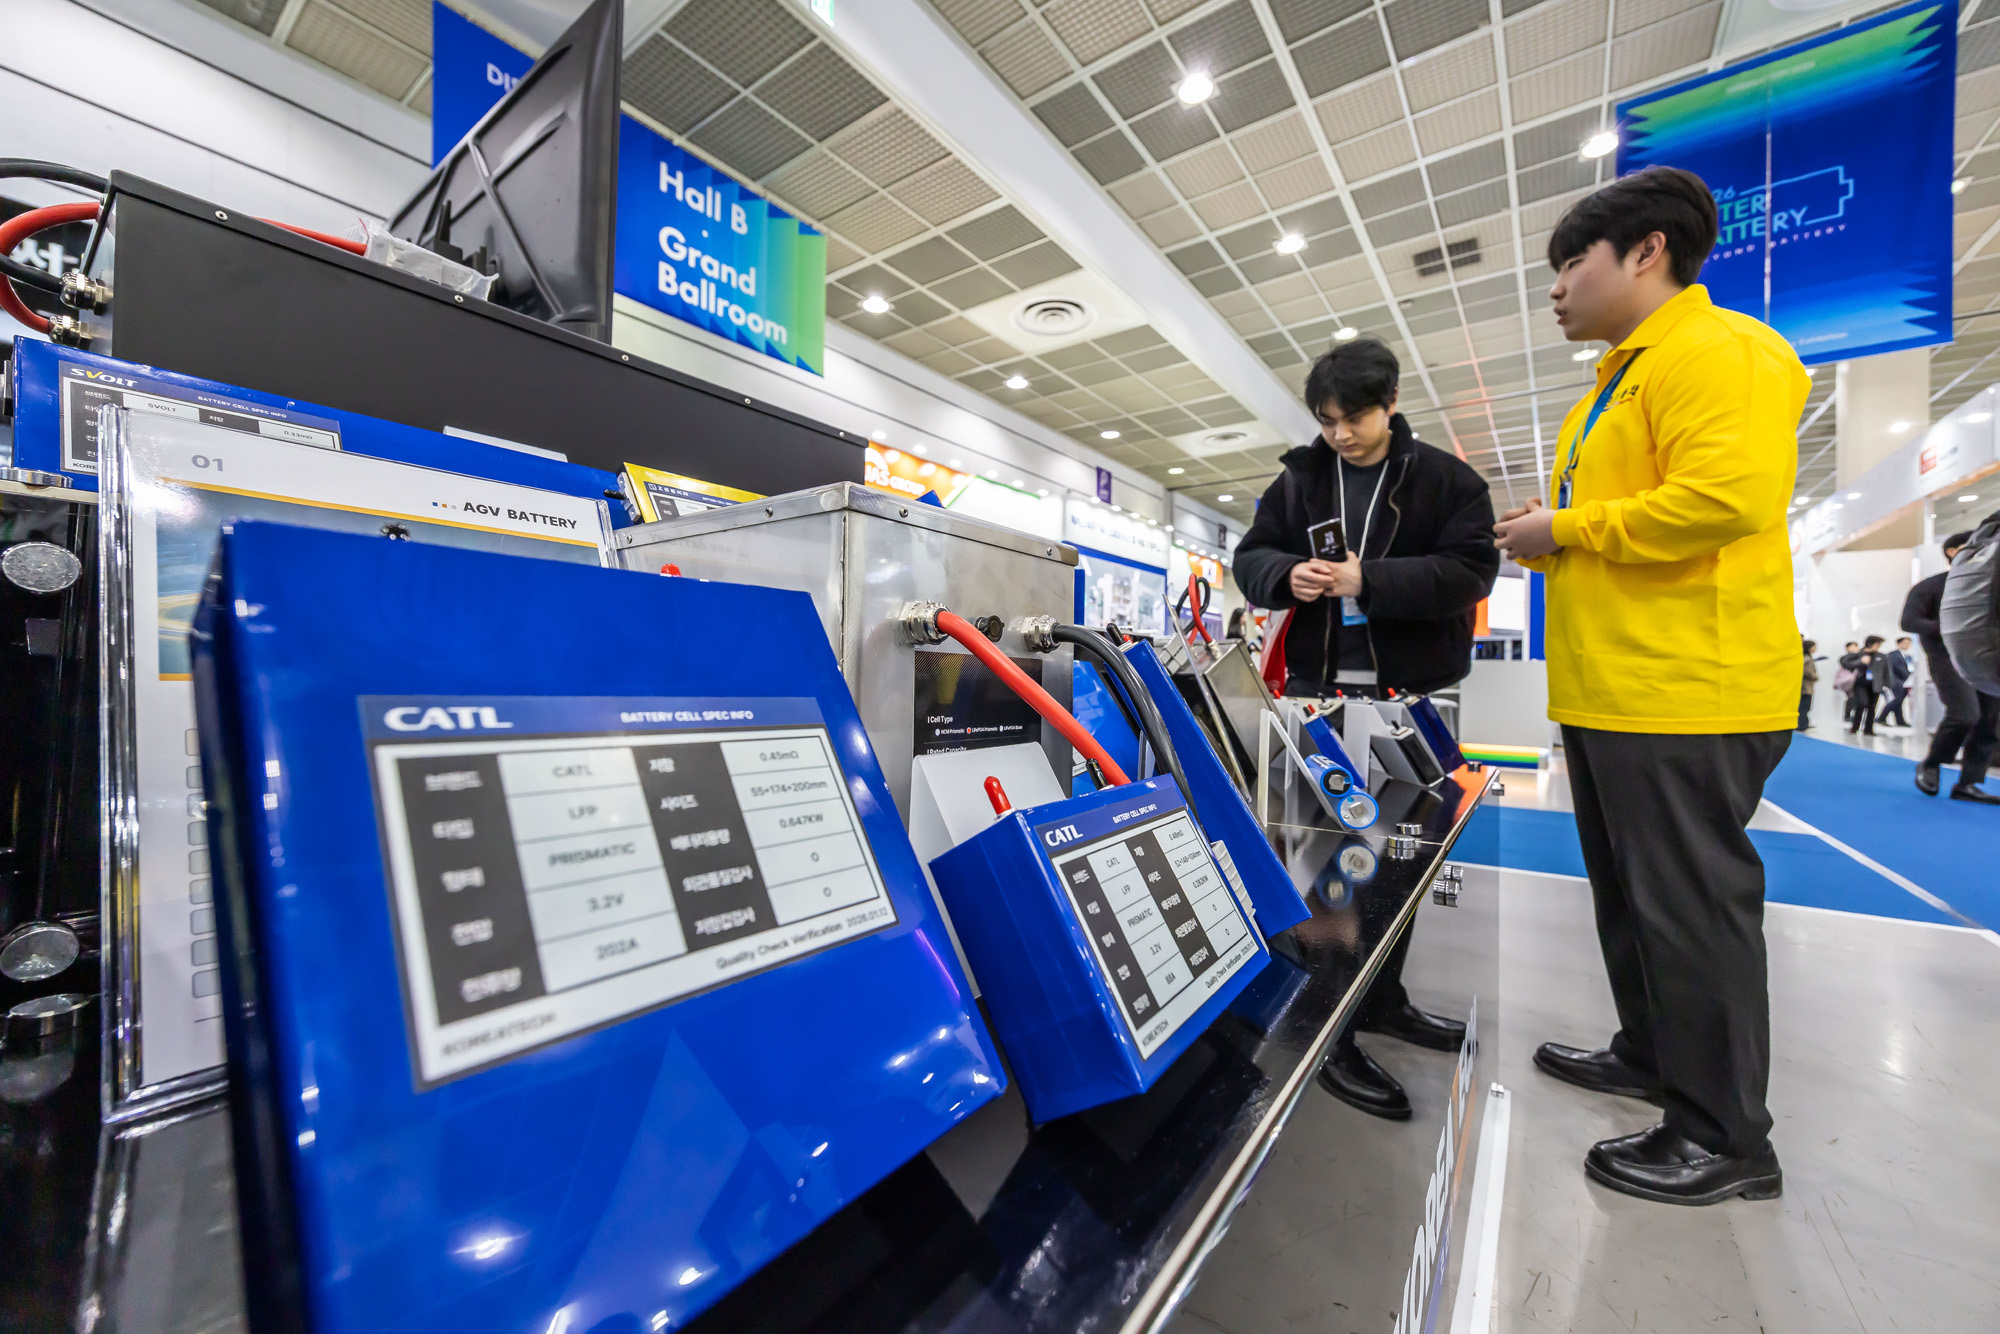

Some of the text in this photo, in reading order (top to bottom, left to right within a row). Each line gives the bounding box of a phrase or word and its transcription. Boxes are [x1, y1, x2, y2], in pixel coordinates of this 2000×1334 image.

[659, 161, 749, 236] Hall B
[658, 226, 756, 297] Grand
[658, 261, 788, 345] Ballroom
[70, 368, 138, 387] SVOLT
[148, 402, 177, 413] SVOLT
[198, 395, 287, 419] BATTERY CELL SPEC INFO
[191, 455, 225, 473] 01
[463, 502, 577, 529] AGV BATTERY
[384, 706, 513, 732] CATL
[621, 710, 754, 724] BATTERY CELL SPEC INFO
[941, 715, 953, 724] Type
[552, 765, 594, 777] CATL
[569, 805, 598, 819] LFP
[1113, 803, 1157, 824] BATTERY CELL SPEC INFO
[1045, 824, 1083, 847] CATL
[549, 843, 636, 868] PRISMATIC
[1106, 856, 1120, 868] CATL
[1121, 884, 1131, 895] LFP
[1127, 908, 1153, 928] PRISMATIC
